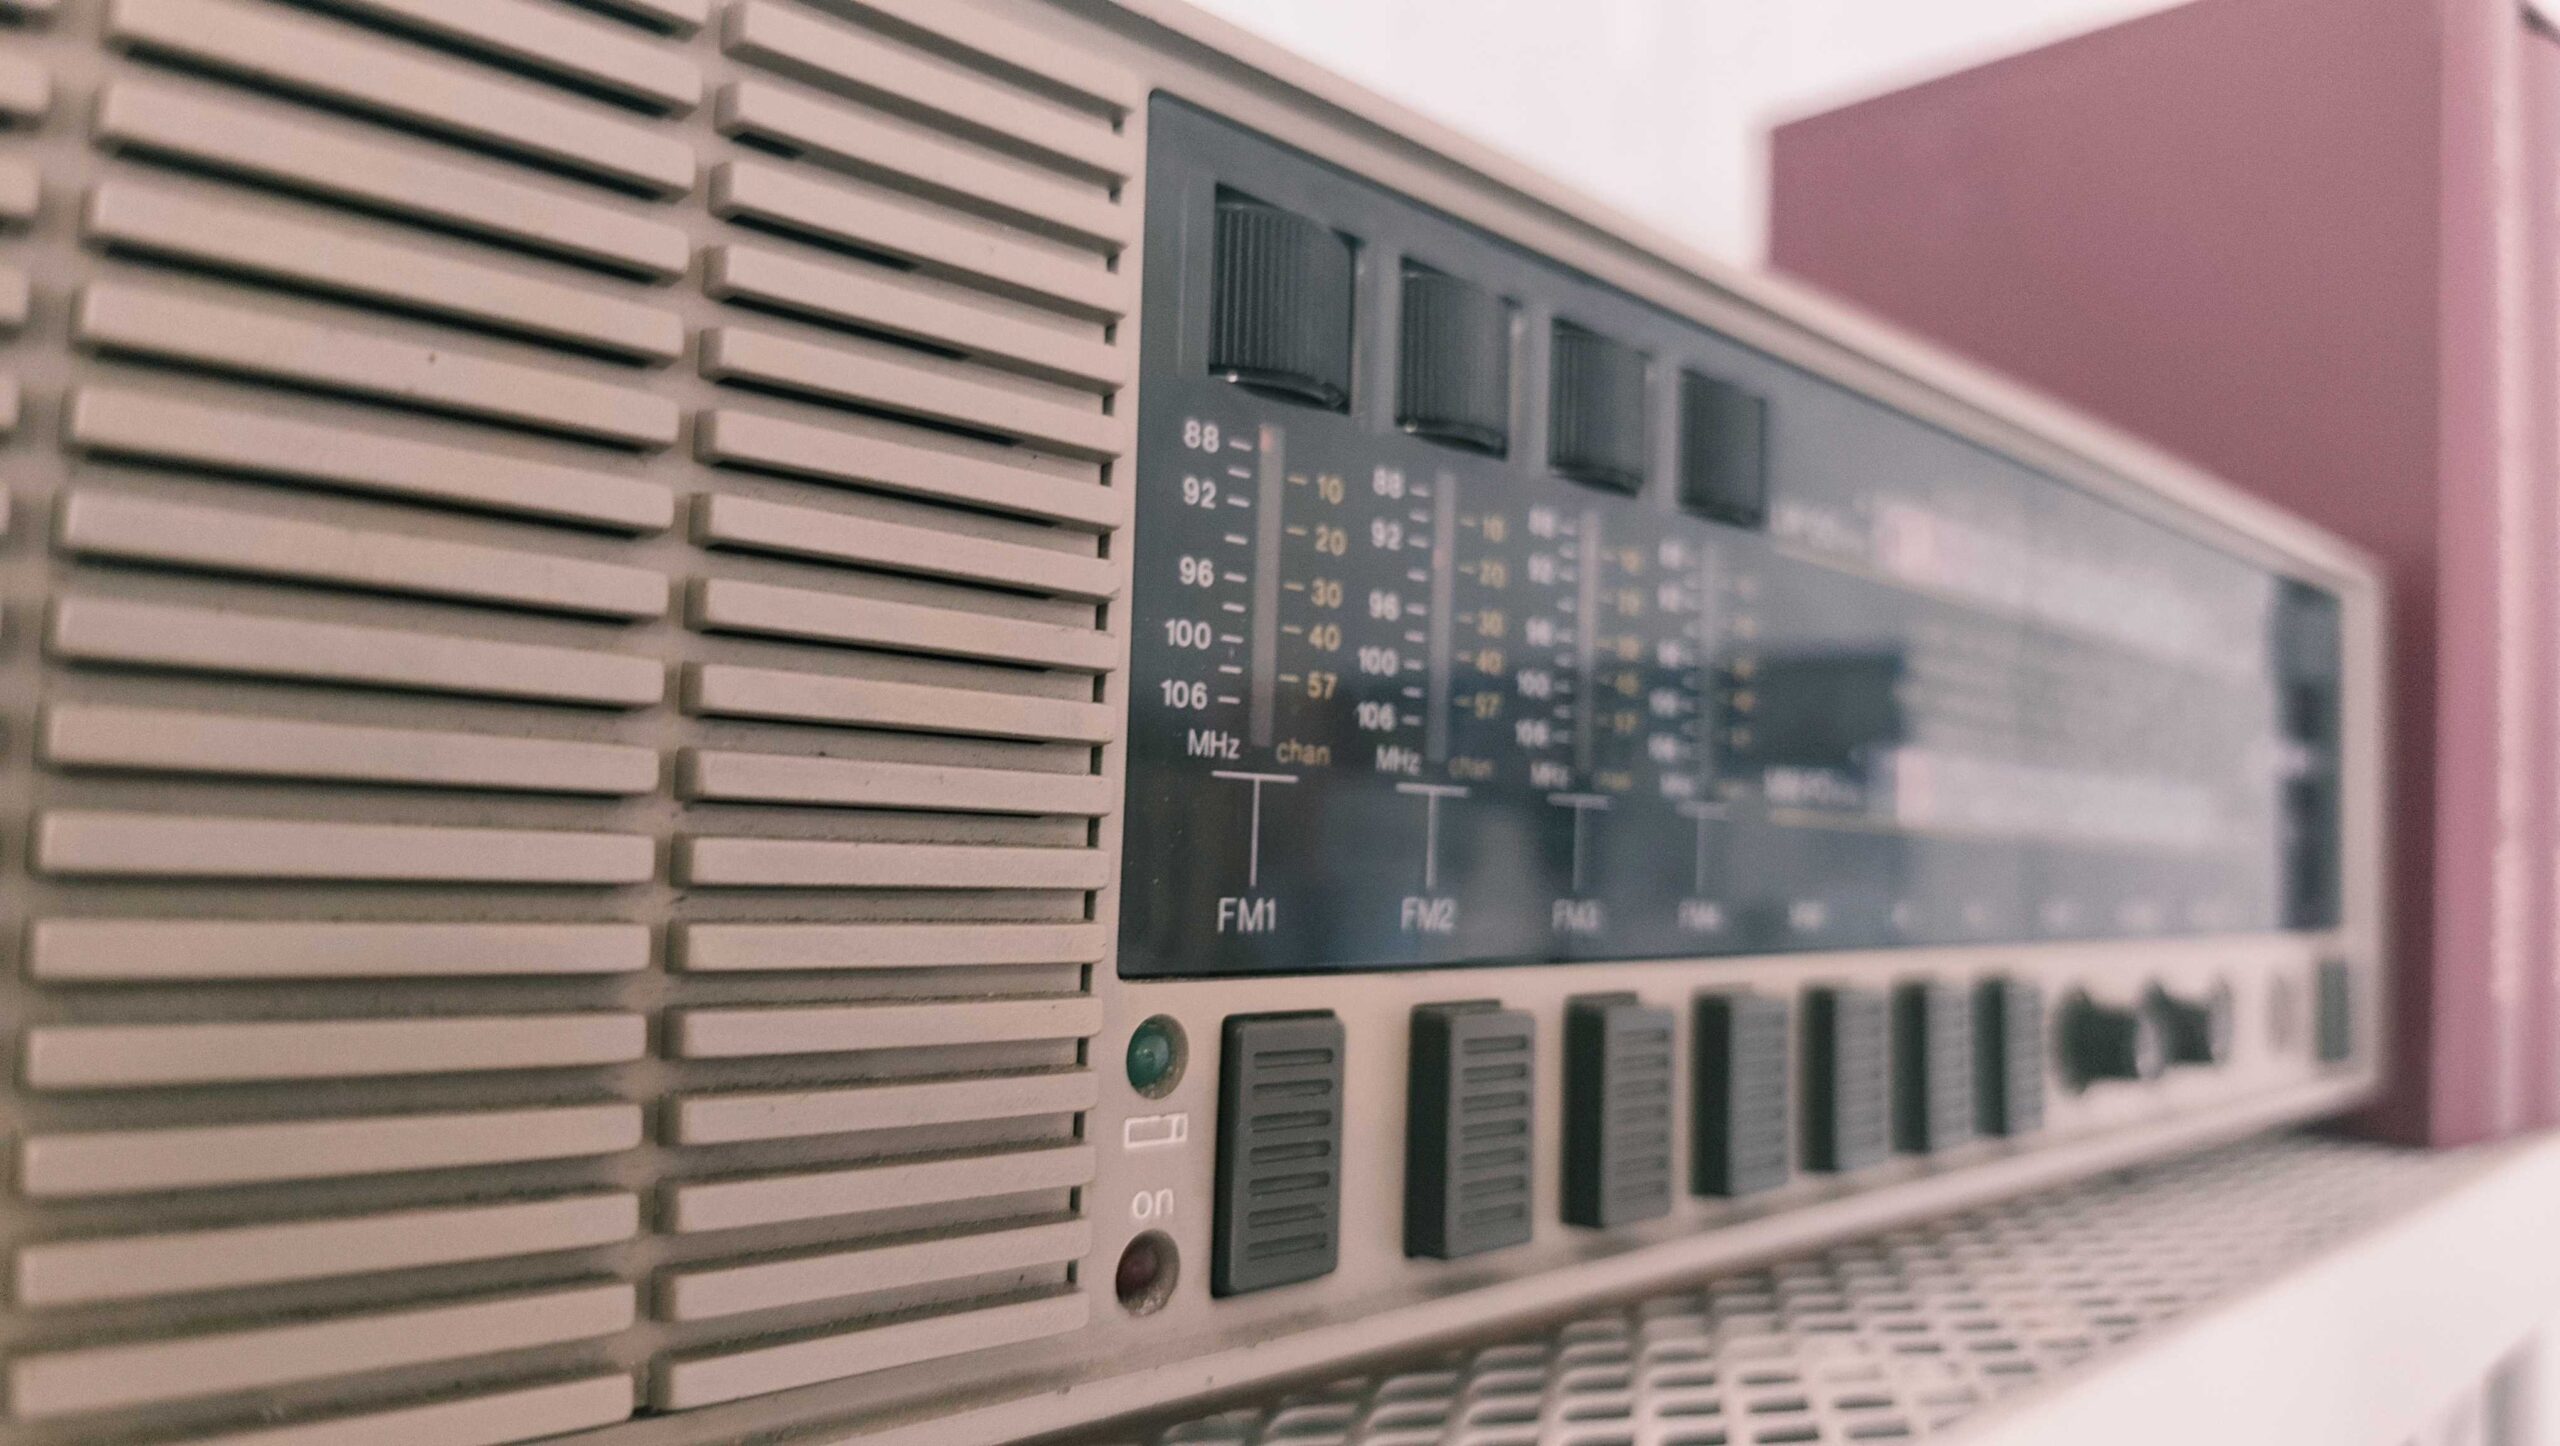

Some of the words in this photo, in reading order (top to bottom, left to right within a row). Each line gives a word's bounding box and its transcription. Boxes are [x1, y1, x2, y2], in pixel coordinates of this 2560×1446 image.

[1183, 420, 1220, 453] 88
[1183, 476, 1216, 510] 92
[1317, 475, 1344, 505] 10
[1315, 525, 1346, 556] 20
[1179, 556, 1215, 587] 96
[1312, 579, 1342, 608] 30
[1165, 619, 1212, 650] 100
[1309, 624, 1341, 651] 40
[1161, 679, 1208, 710] 106
[1307, 670, 1338, 700] 57
[1187, 729, 1240, 759] MHz
[1276, 739, 1331, 765] chan
[1376, 745, 1421, 775] MHz
[1217, 897, 1276, 933] FM1
[1401, 897, 1457, 931] FM2
[1132, 1188, 1174, 1220] on
